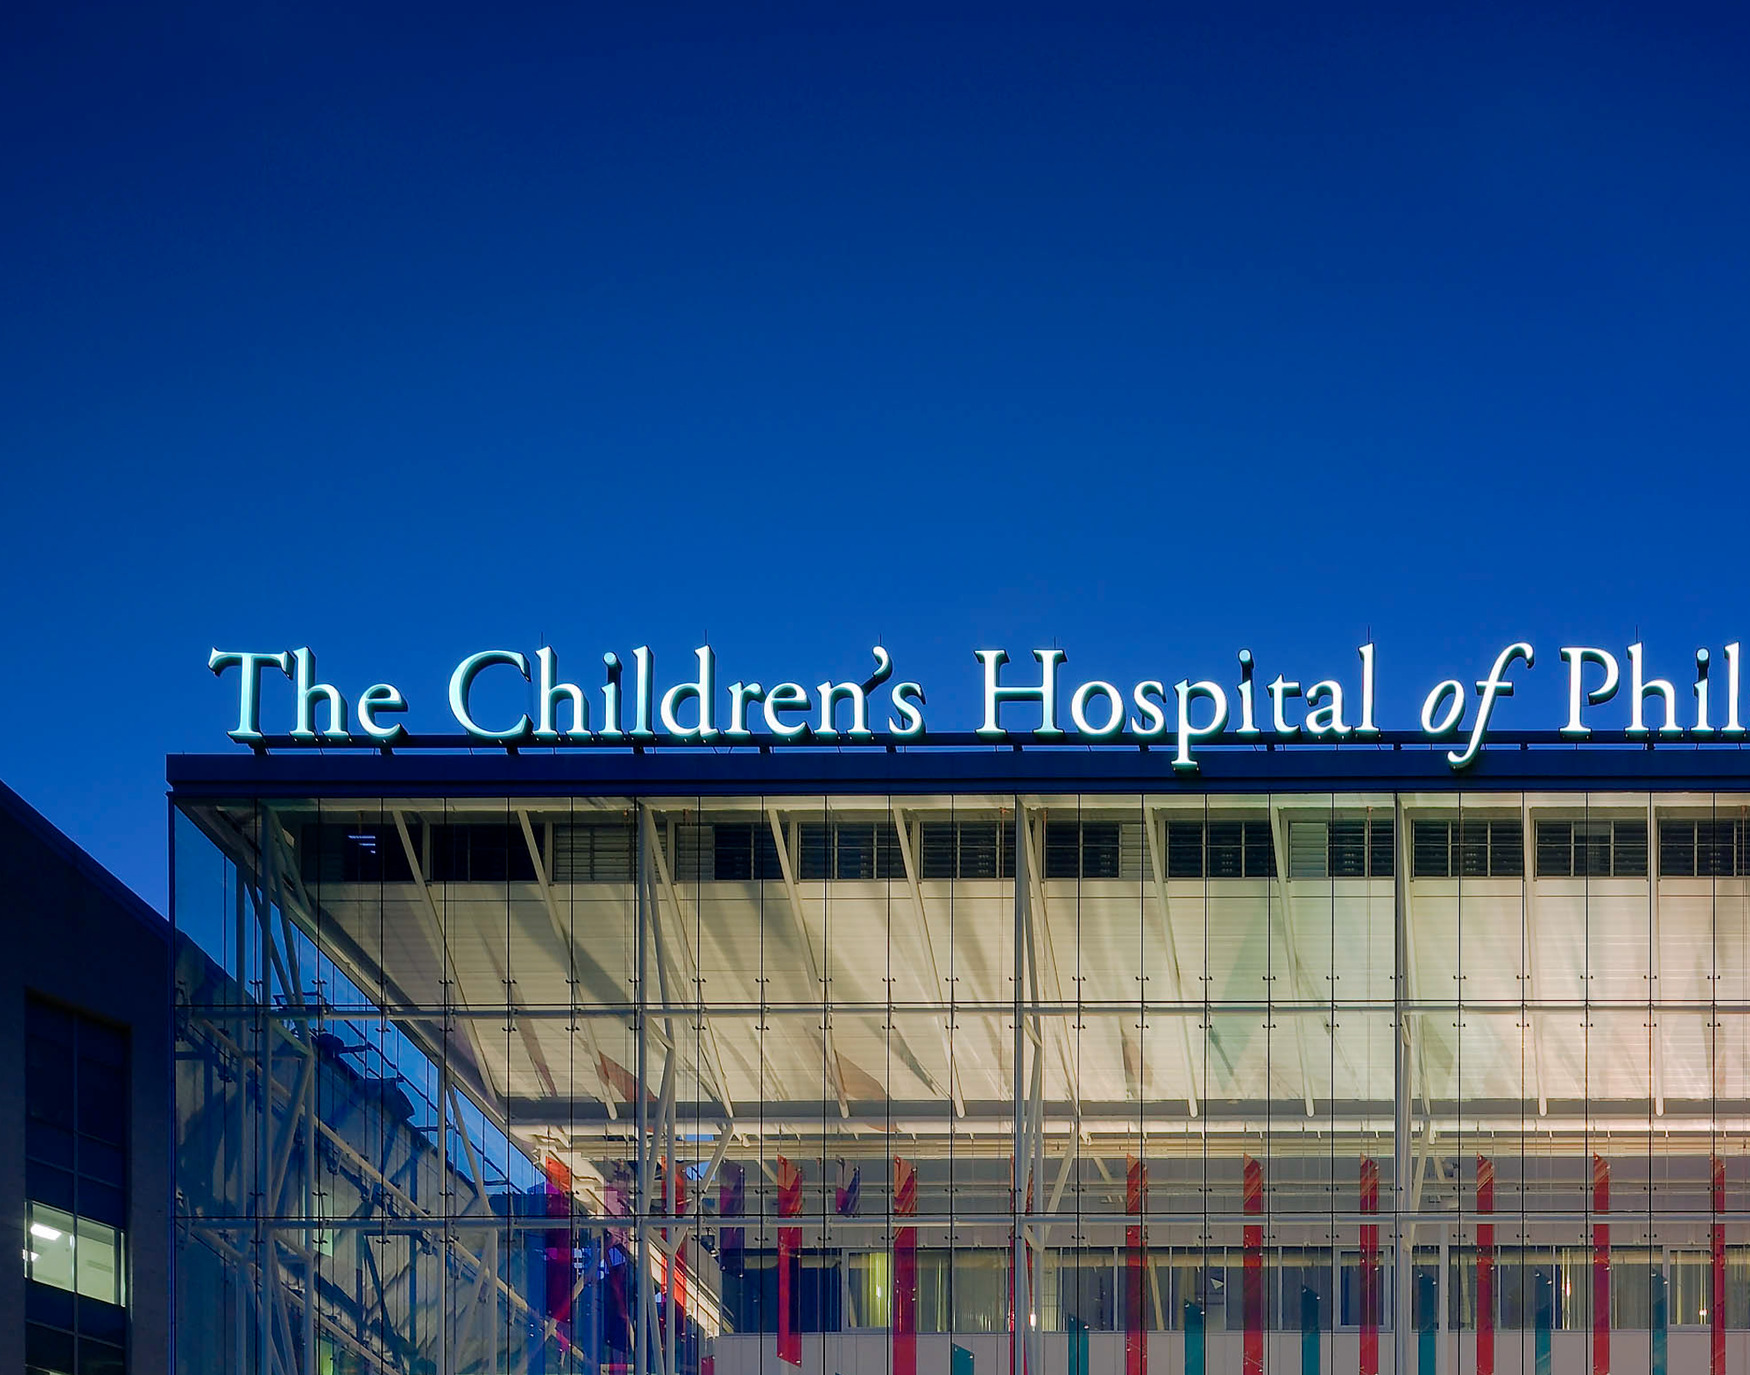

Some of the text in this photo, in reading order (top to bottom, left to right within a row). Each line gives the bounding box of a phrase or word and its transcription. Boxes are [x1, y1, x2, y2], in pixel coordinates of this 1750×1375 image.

[208, 647, 407, 739] The
[448, 645, 926, 740] Children's
[974, 643, 1378, 771] Hospital
[1421, 642, 1535, 770] of
